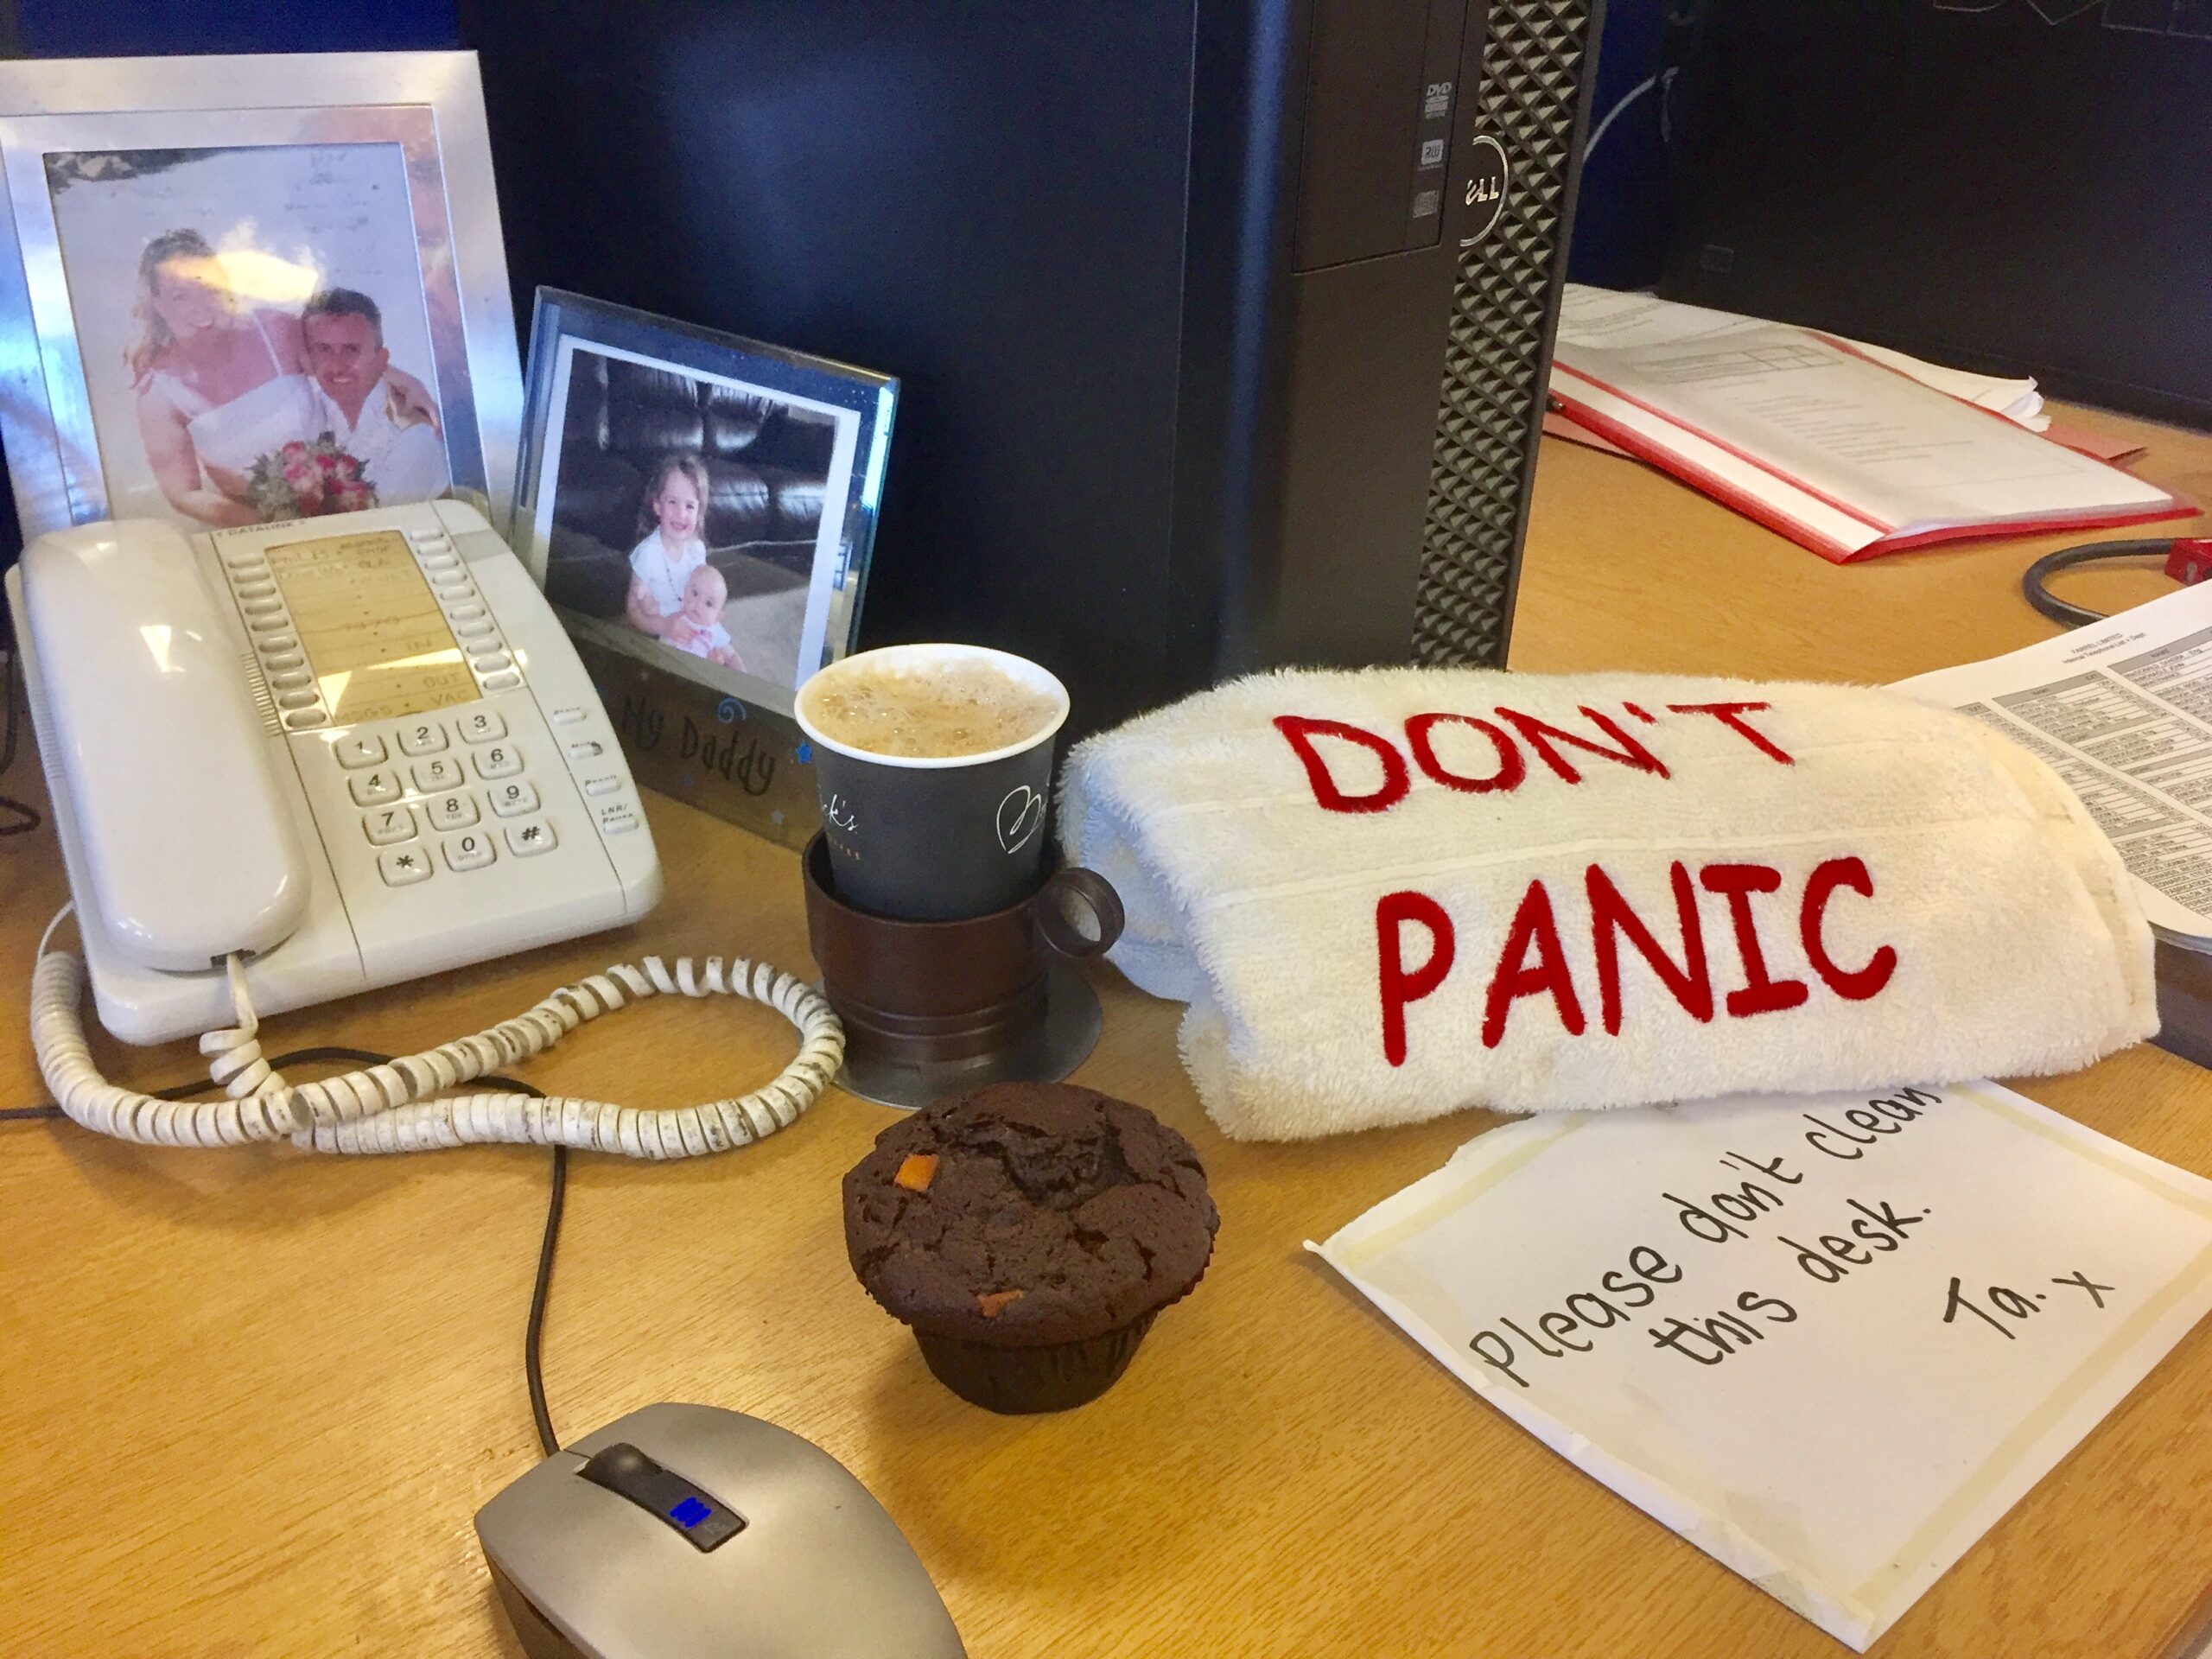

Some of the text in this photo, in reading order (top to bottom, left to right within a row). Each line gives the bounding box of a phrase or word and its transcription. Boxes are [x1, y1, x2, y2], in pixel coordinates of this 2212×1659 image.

[1427, 82, 1452, 96] DVD
[416, 726, 429, 740] 2
[474, 715, 487, 728] 3
[623, 694, 776, 797] My Daddy
[1274, 702, 1794, 814] DON'T
[368, 748, 504, 786] 4 5 6
[381, 785, 520, 826] 7 8 9
[461, 836, 475, 852] 0
[1376, 856, 1897, 1068] PANIC
[1470, 1086, 1942, 1388] Please don't clean
[1648, 1198, 1933, 1366] this desk.
[1942, 1276, 2048, 1341] Ta.
